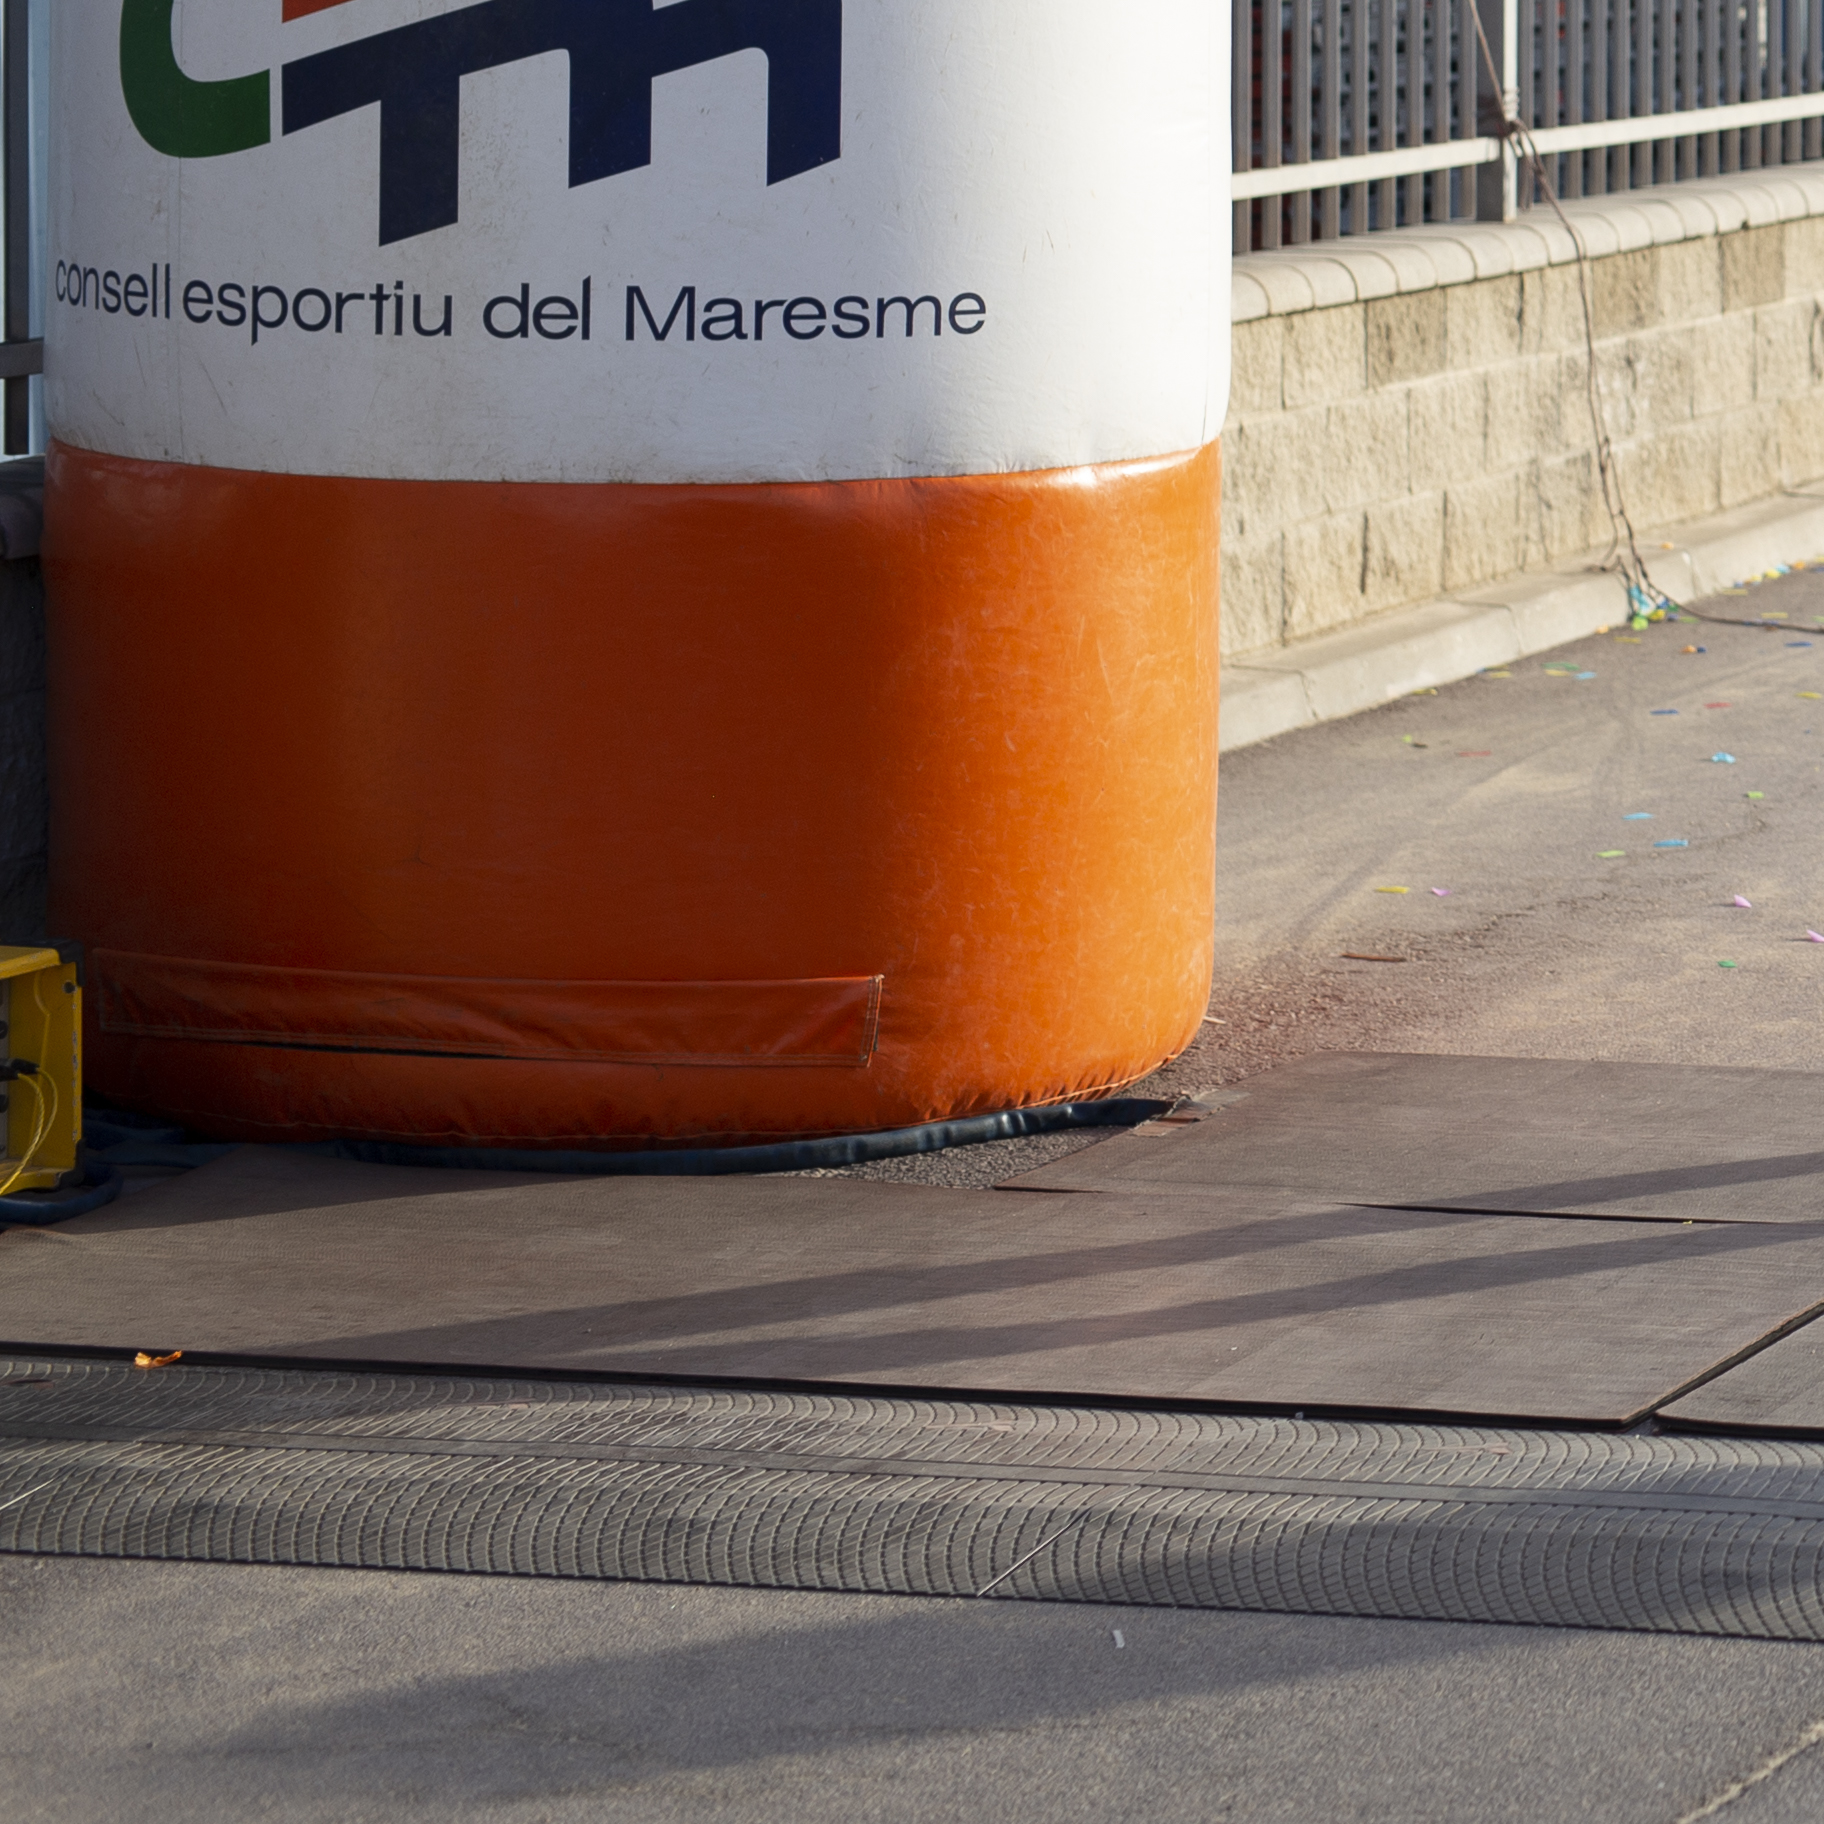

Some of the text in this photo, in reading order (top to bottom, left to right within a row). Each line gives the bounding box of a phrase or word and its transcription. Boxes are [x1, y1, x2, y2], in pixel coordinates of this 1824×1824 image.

[54, 259, 987, 346] consell esportiu del Maresme
